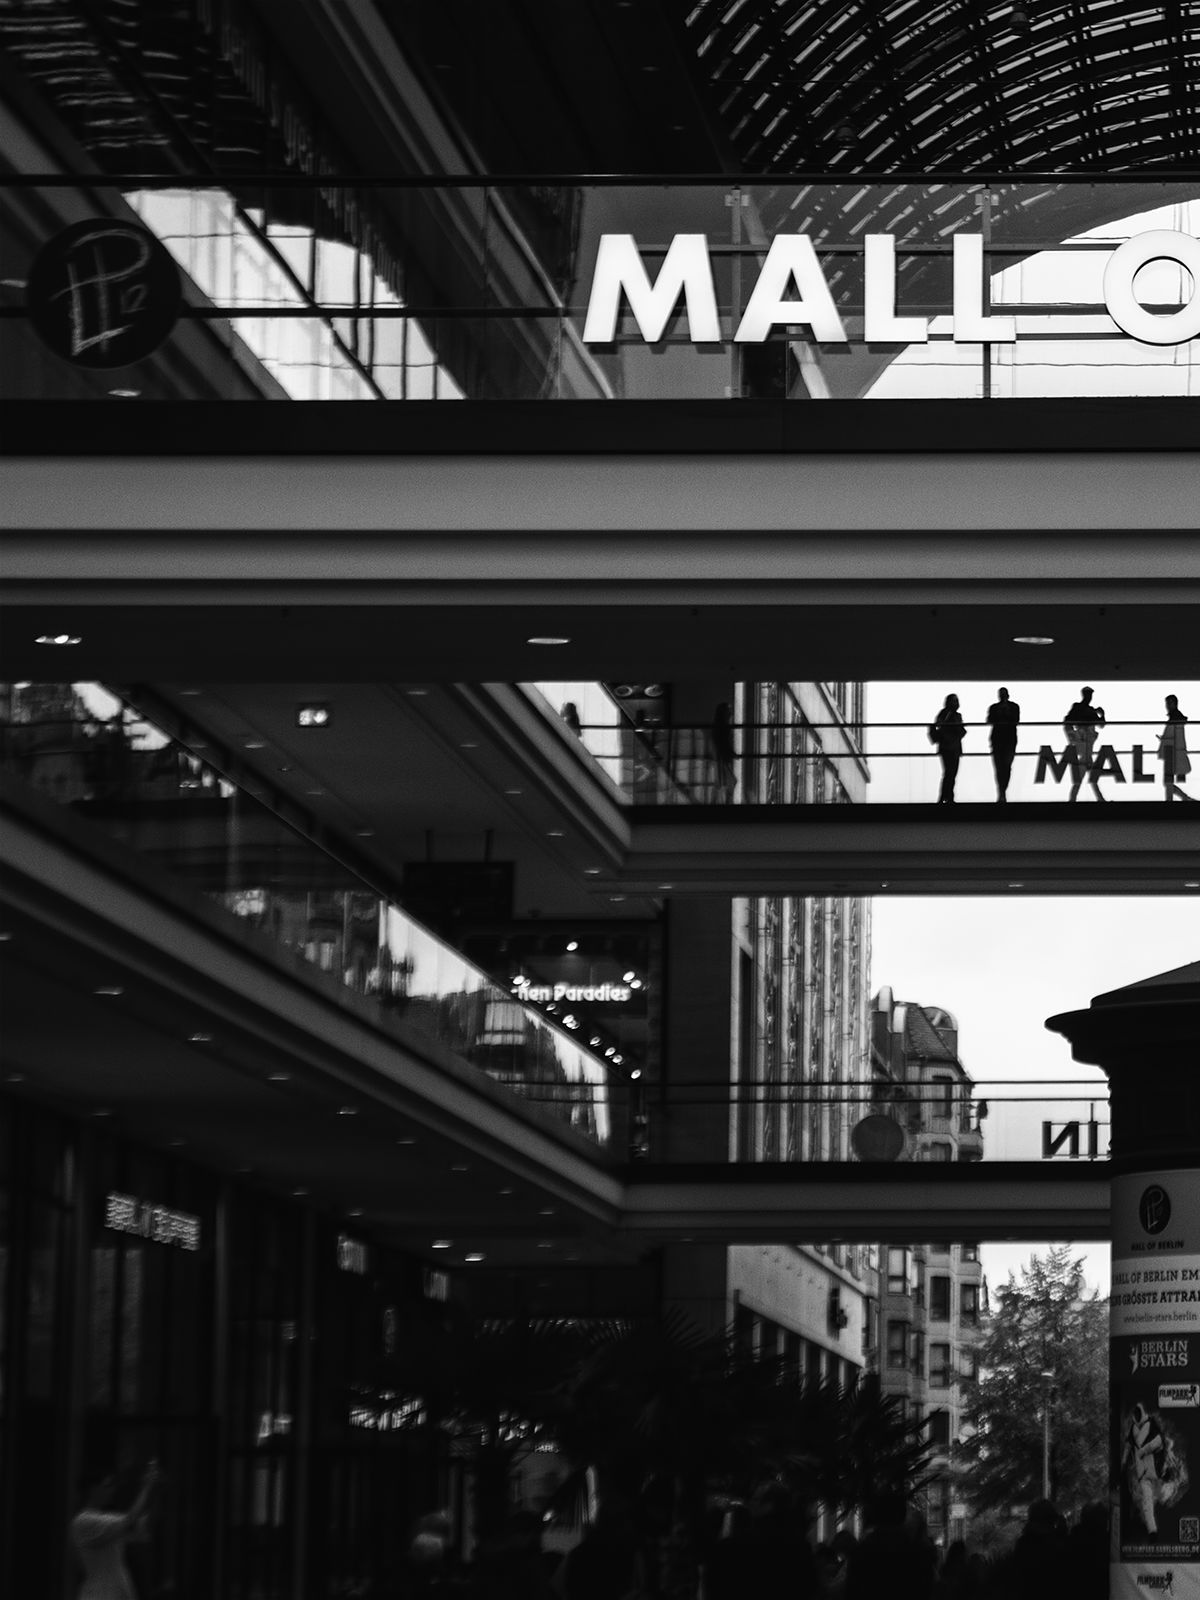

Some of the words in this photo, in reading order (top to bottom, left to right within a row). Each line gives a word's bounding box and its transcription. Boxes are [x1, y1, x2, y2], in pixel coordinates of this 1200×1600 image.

[582, 232, 1017, 344] MALL
[1034, 743, 1187, 785] MALL
[553, 982, 632, 1002] Paradies
[1157, 1239, 1185, 1250] BERLIN
[1130, 1272, 1142, 1284] OF
[1143, 1270, 1178, 1283] BERLIN
[1122, 1290, 1158, 1306] GRÖSSTE
[1141, 1340, 1188, 1354] BERLIN
[1140, 1353, 1188, 1367] STARS
